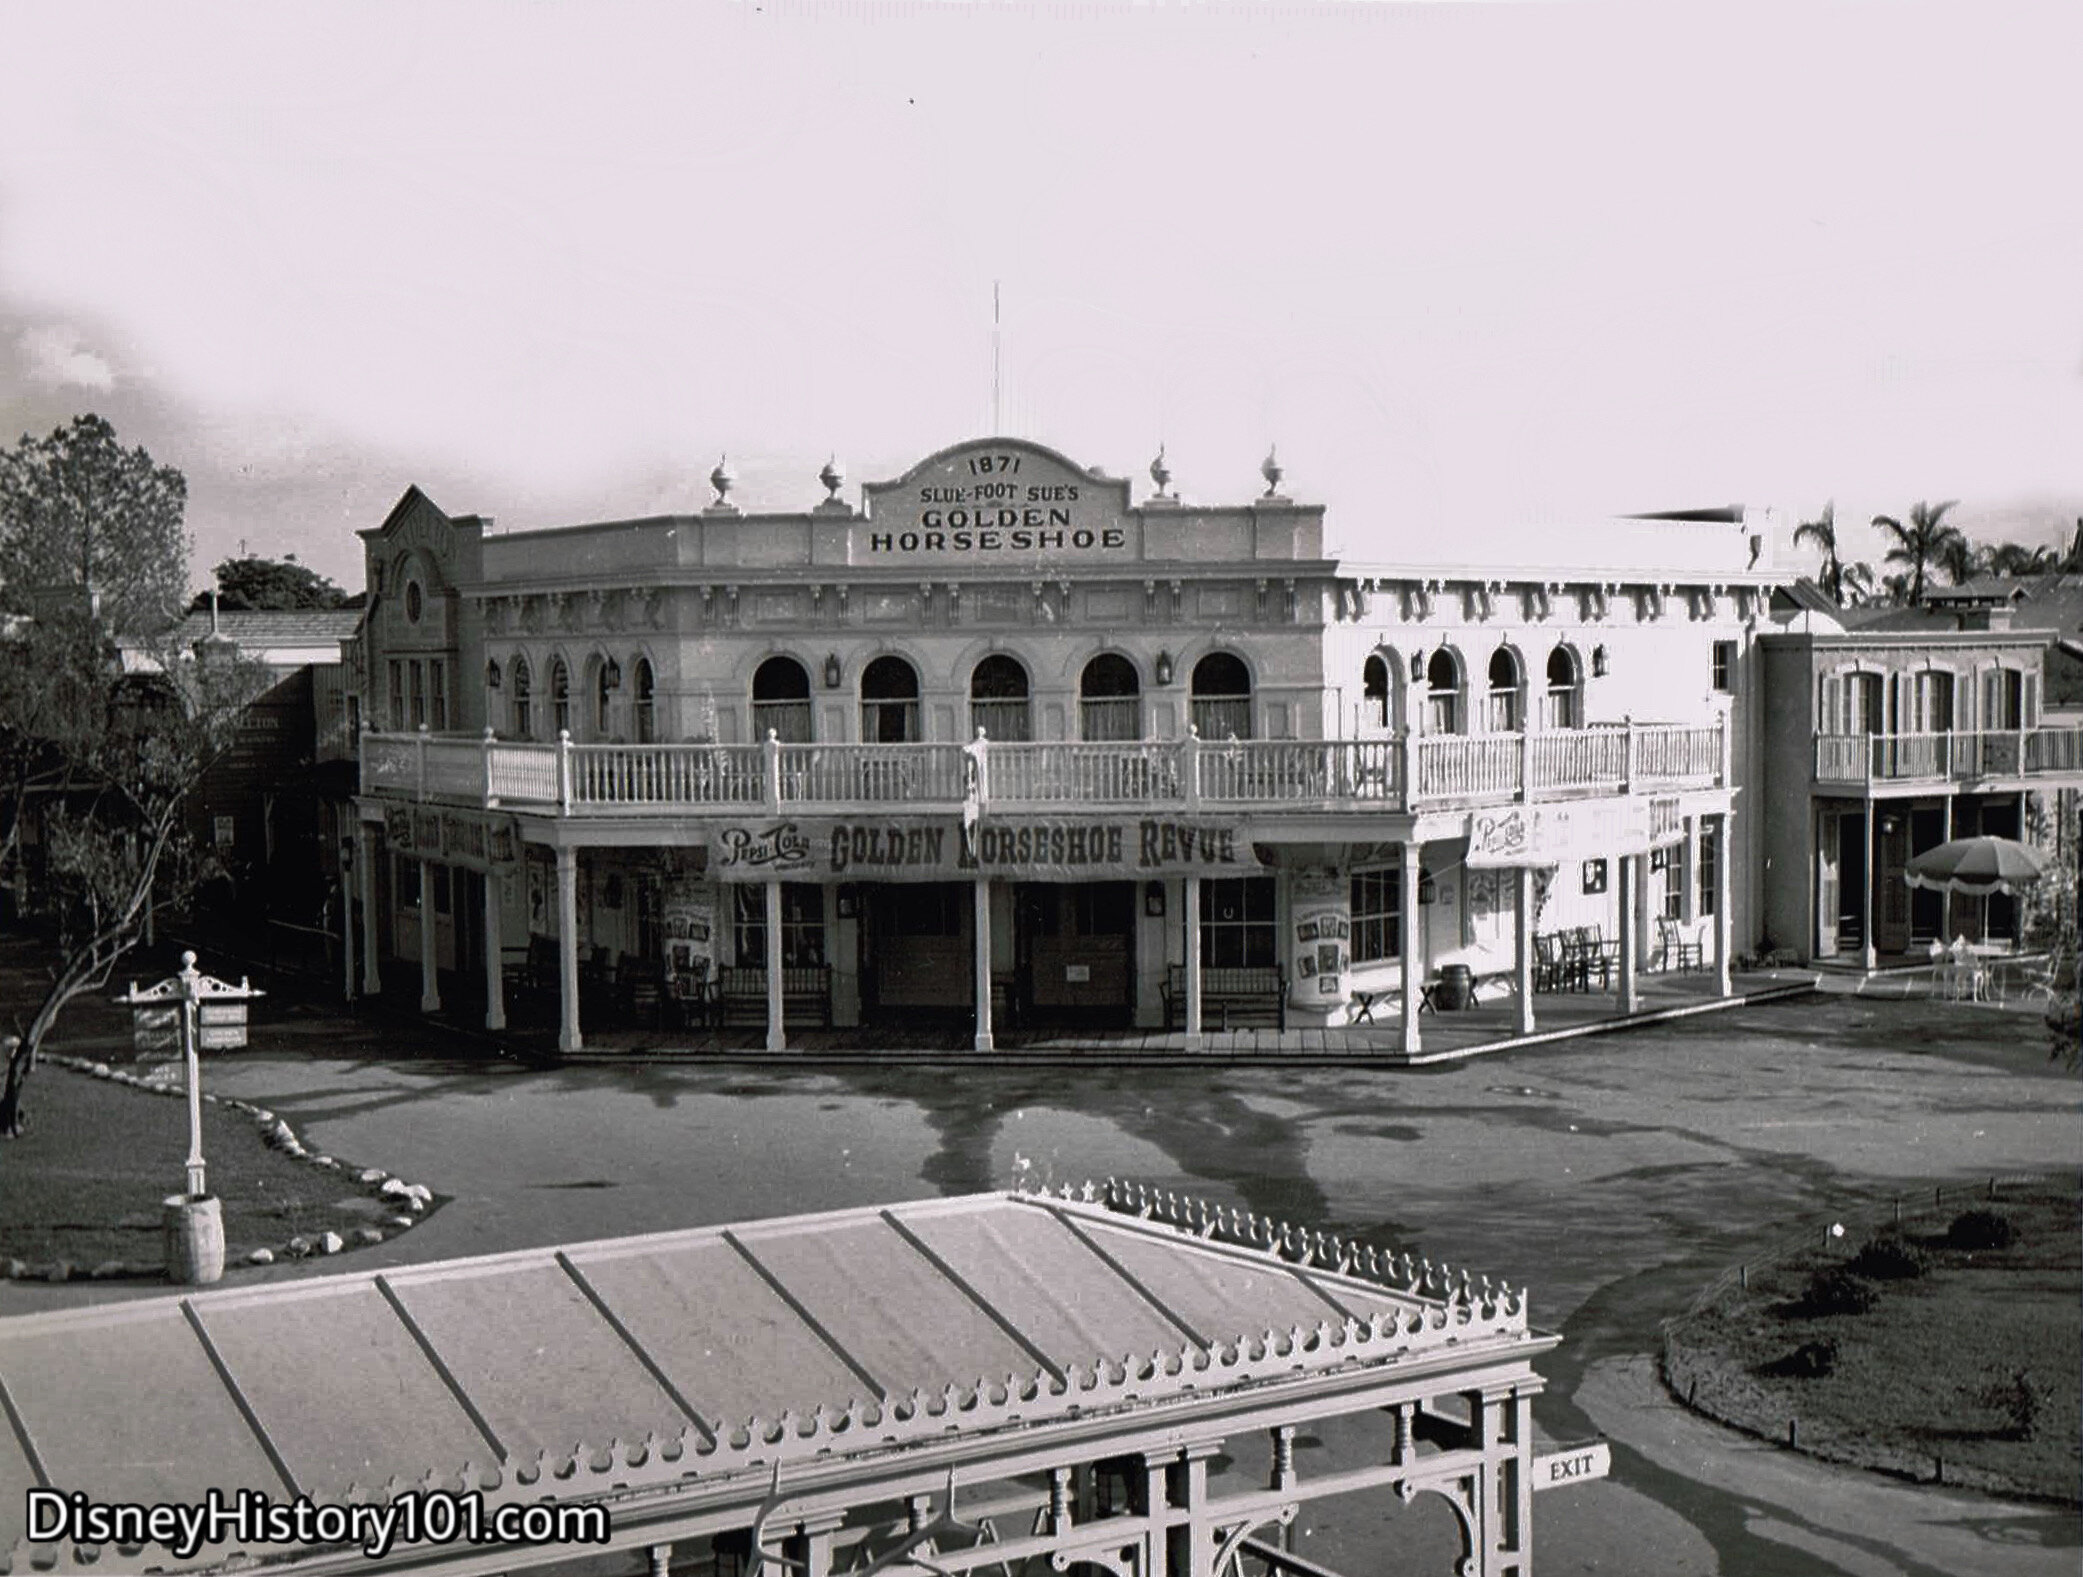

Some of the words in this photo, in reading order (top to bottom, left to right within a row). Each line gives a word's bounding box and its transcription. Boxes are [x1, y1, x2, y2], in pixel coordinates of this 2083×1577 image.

[968, 455, 1021, 476] 1871
[919, 482, 1019, 503] SLUE-FOOT
[1026, 484, 1080, 502] SUE'S
[921, 507, 1071, 529] GOLDEN
[869, 528, 1127, 552] HORSESHOE
[830, 825, 945, 872] GOLDEN
[956, 818, 1123, 869] HORSESHOE
[1138, 819, 1236, 867] REVUE
[1550, 1453, 1594, 1481] EXIT
